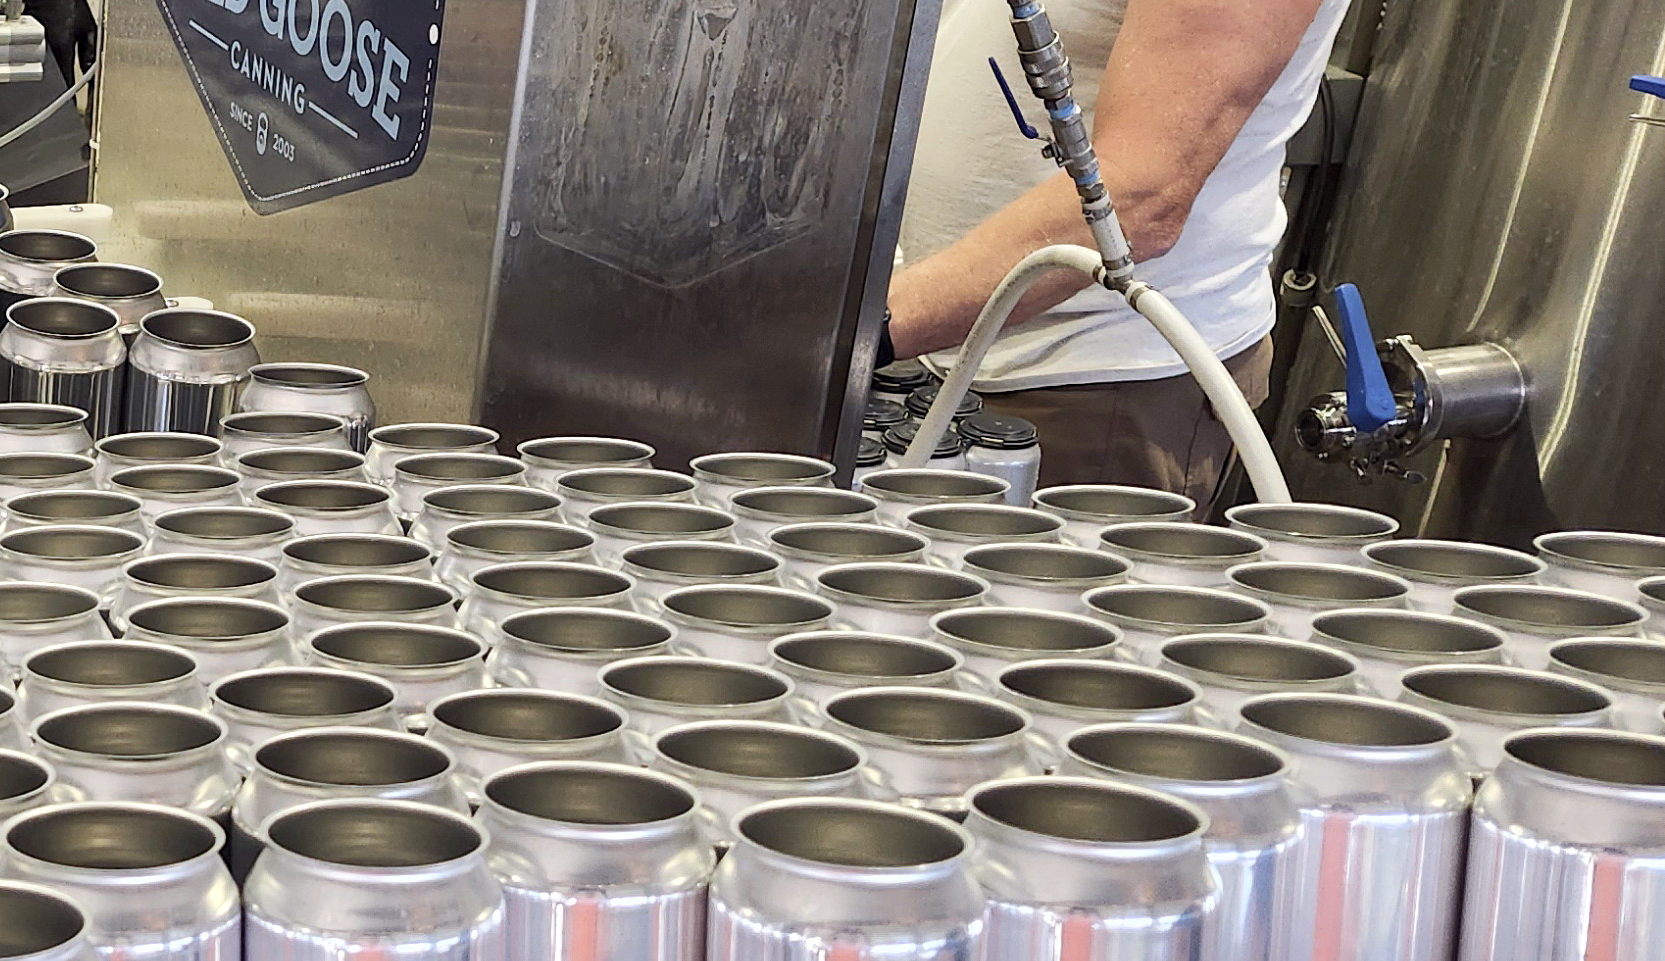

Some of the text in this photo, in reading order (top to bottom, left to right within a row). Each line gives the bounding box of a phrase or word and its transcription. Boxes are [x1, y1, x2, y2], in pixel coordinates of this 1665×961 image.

[229, 40, 305, 114] CANNING
[229, 101, 295, 162] SINCE 2003
